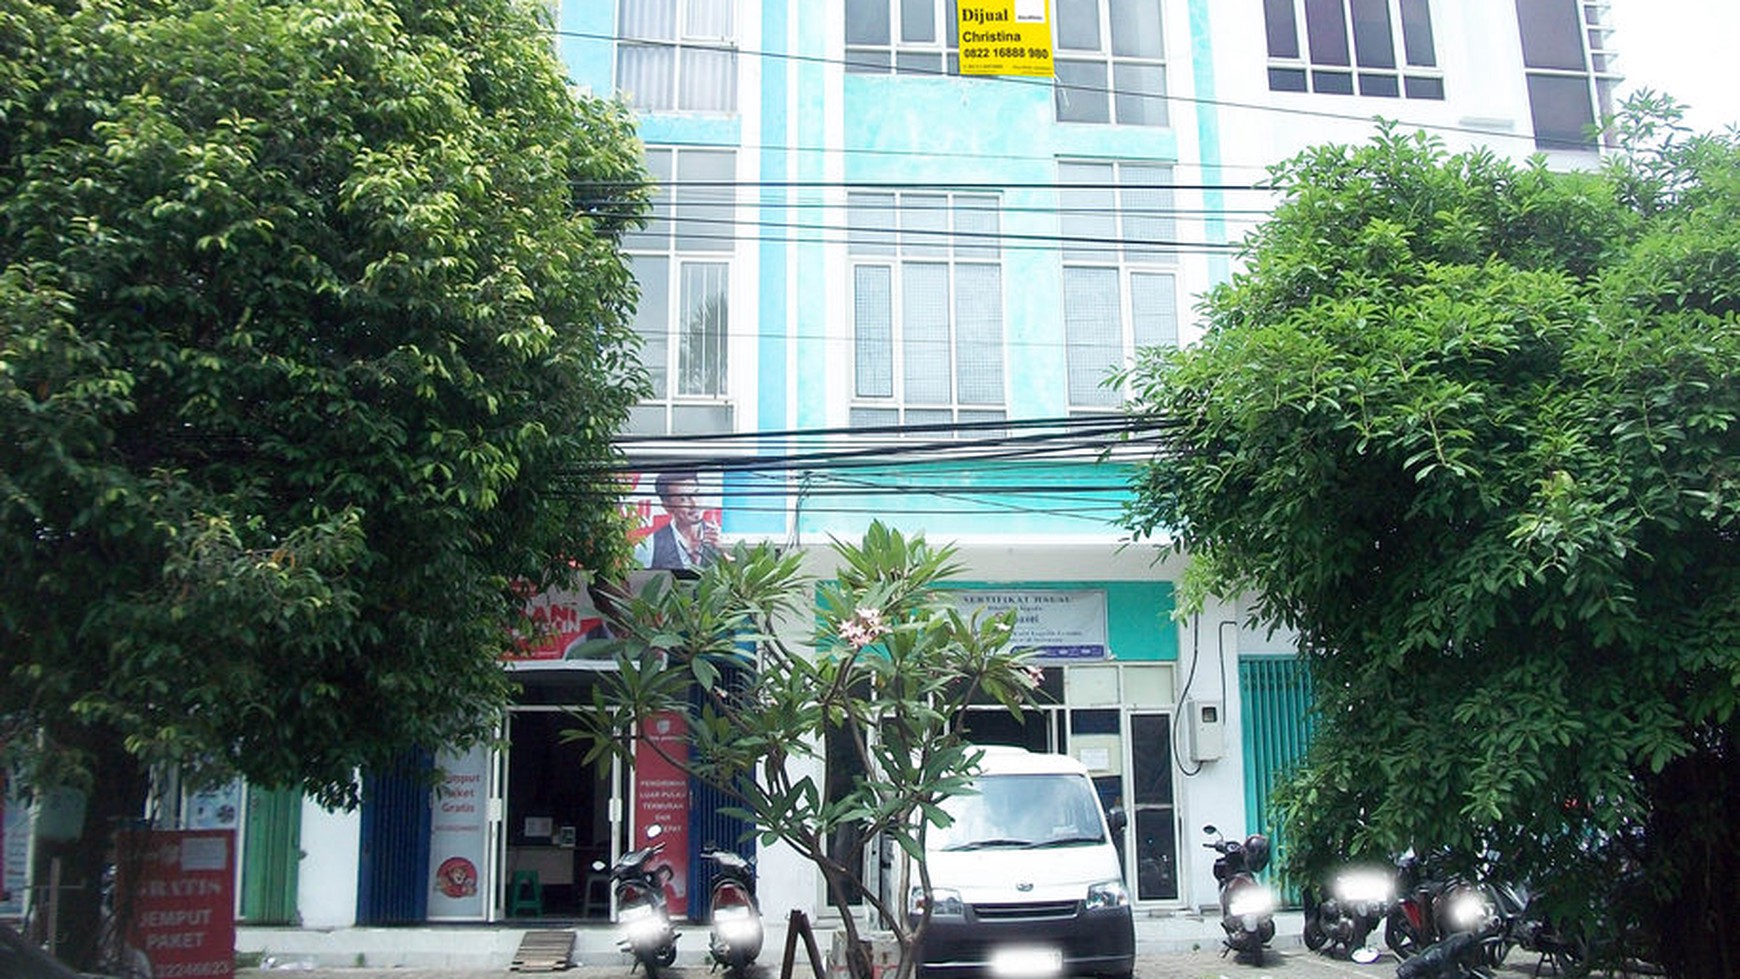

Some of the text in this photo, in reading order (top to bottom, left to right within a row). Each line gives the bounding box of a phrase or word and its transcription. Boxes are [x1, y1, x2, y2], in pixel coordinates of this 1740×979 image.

[962, 8, 1008, 25] Dijual
[962, 31, 1021, 42] Christina
[963, 47, 990, 58] 0822
[993, 47, 1026, 58] 16888
[145, 931, 206, 951] PAKET
